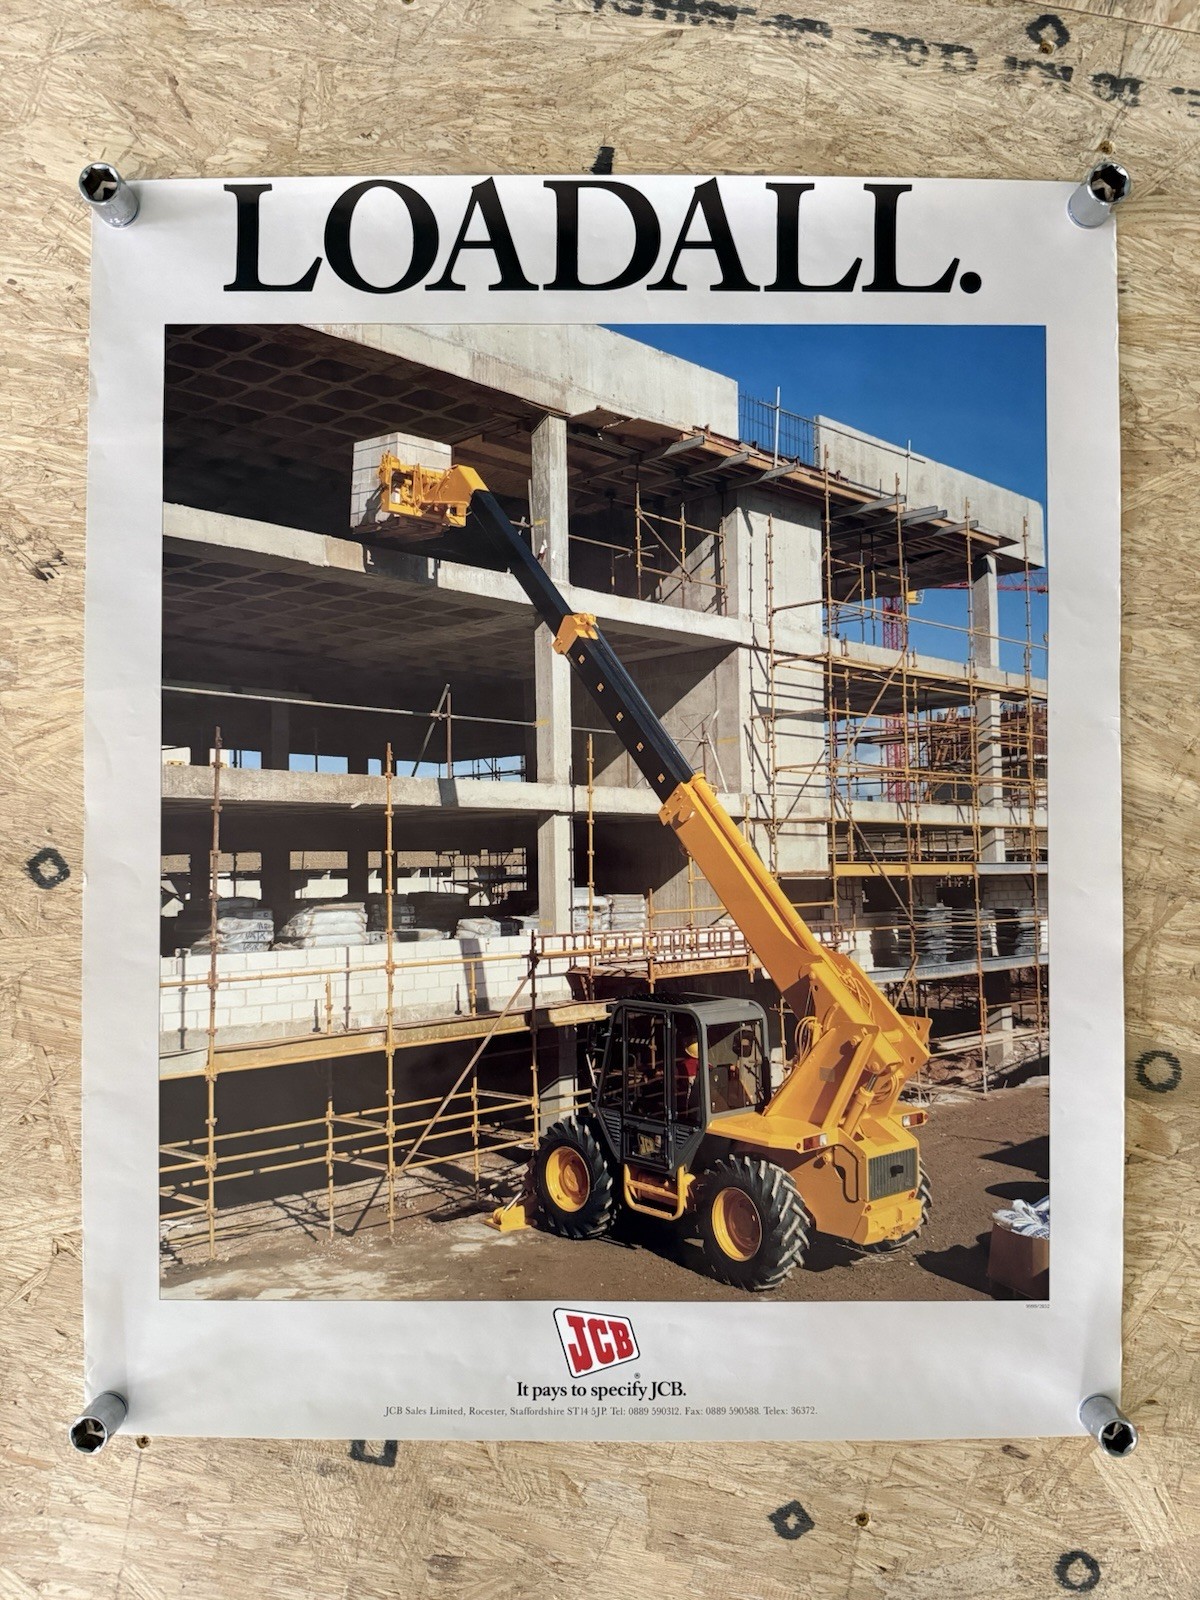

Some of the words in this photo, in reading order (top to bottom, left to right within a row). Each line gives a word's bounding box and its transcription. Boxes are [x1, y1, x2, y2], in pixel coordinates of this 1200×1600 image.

[223, 176, 983, 294] LOADALL.
[566, 1315, 634, 1373] JCB
[516, 1381, 529, 1397] It
[531, 1383, 568, 1402] pays
[571, 1384, 587, 1397] to
[590, 1380, 648, 1402] specify
[648, 1381, 687, 1401] JCB.
[383, 1406, 403, 1418] JCB
[405, 1406, 427, 1416] Sales
[429, 1406, 466, 1418] Limited,
[468, 1406, 508, 1417] Rocester,
[509, 1406, 565, 1416] Staffordshire
[566, 1406, 589, 1416] ST14
[591, 1406, 609, 1418] 5JP.
[609, 1406, 627, 1416] Tel:
[628, 1406, 650, 1416] 0889
[651, 1406, 682, 1416] 590312.
[684, 1406, 704, 1416] Fax:
[705, 1406, 727, 1416] 0889
[728, 1406, 761, 1416] 590588.
[762, 1406, 789, 1416] Telex:
[790, 1405, 818, 1416] 36372.
